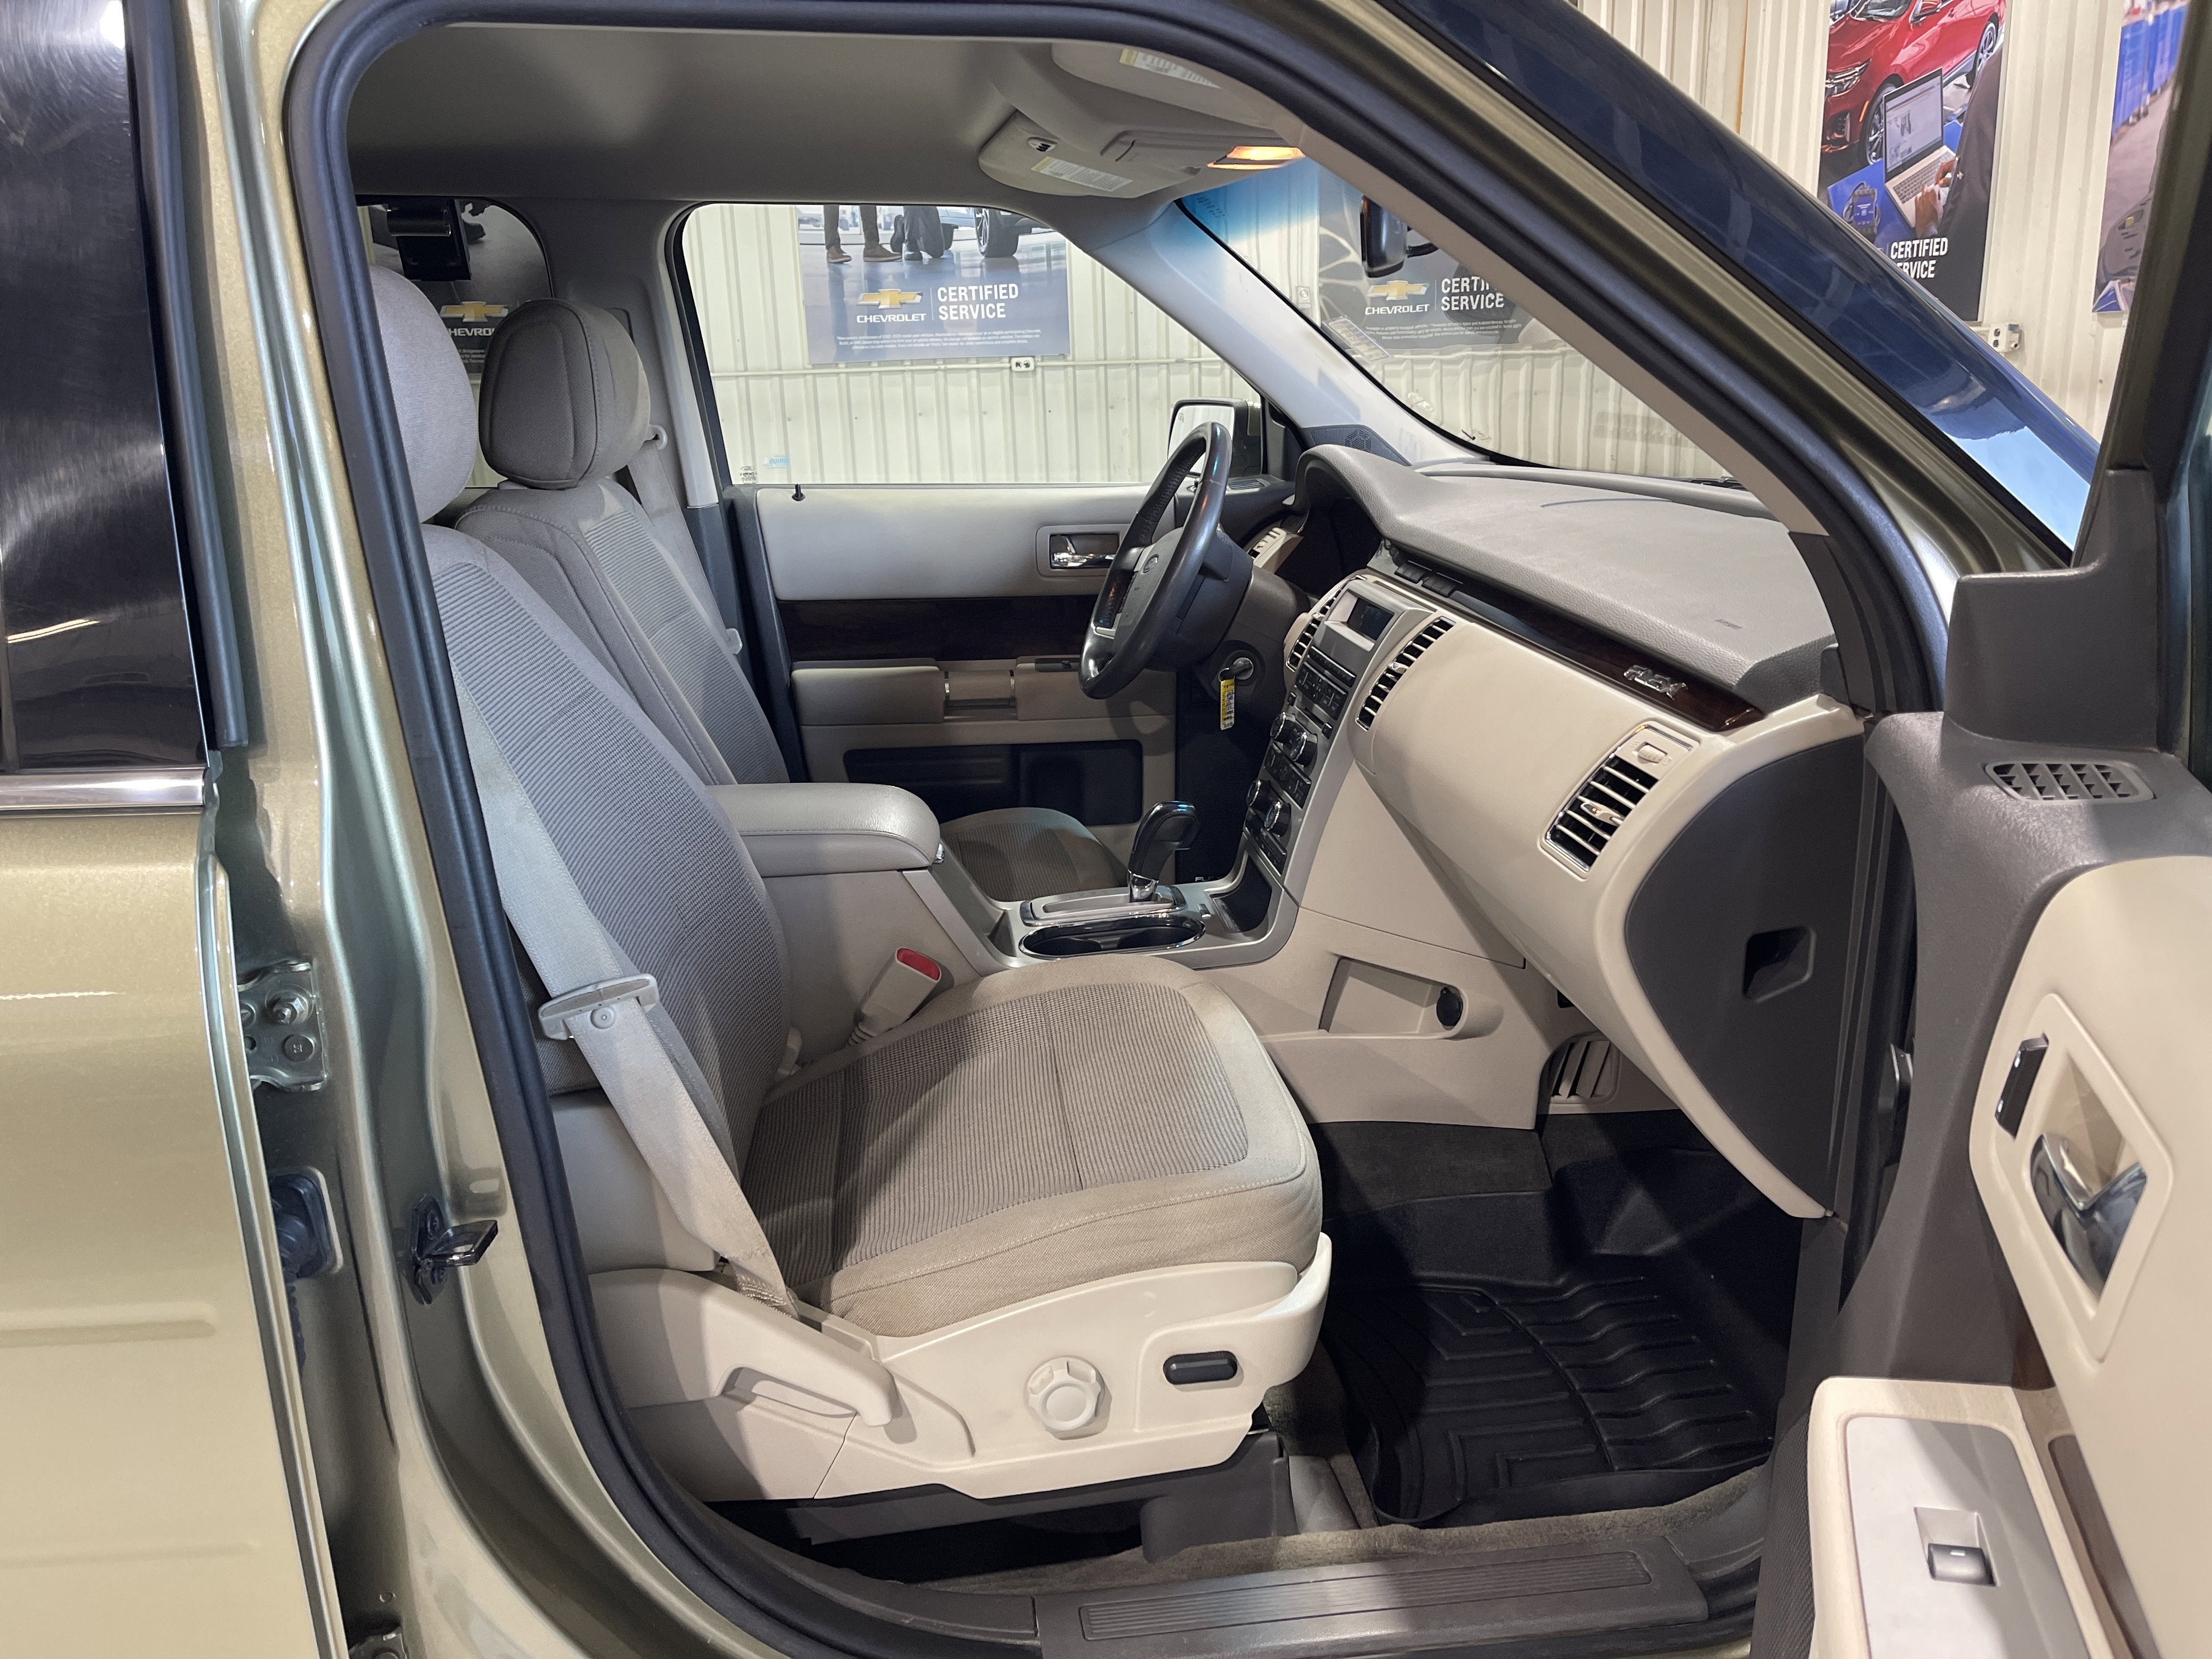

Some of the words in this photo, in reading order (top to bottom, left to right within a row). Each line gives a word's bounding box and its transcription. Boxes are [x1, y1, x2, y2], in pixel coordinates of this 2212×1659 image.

[1891, 238, 1948, 259] CERTIFIED
[1897, 260, 1937, 279] RVICE
[938, 284, 1019, 302] CERTIFIED
[1441, 276, 1489, 293] CERTI
[1365, 304, 1430, 315] CHEVROLET
[1441, 292, 1504, 311] SERVICE
[856, 313, 926, 323] CHEVROLET
[938, 303, 1006, 320] SERVICE
[448, 328, 495, 336] HEVRO
